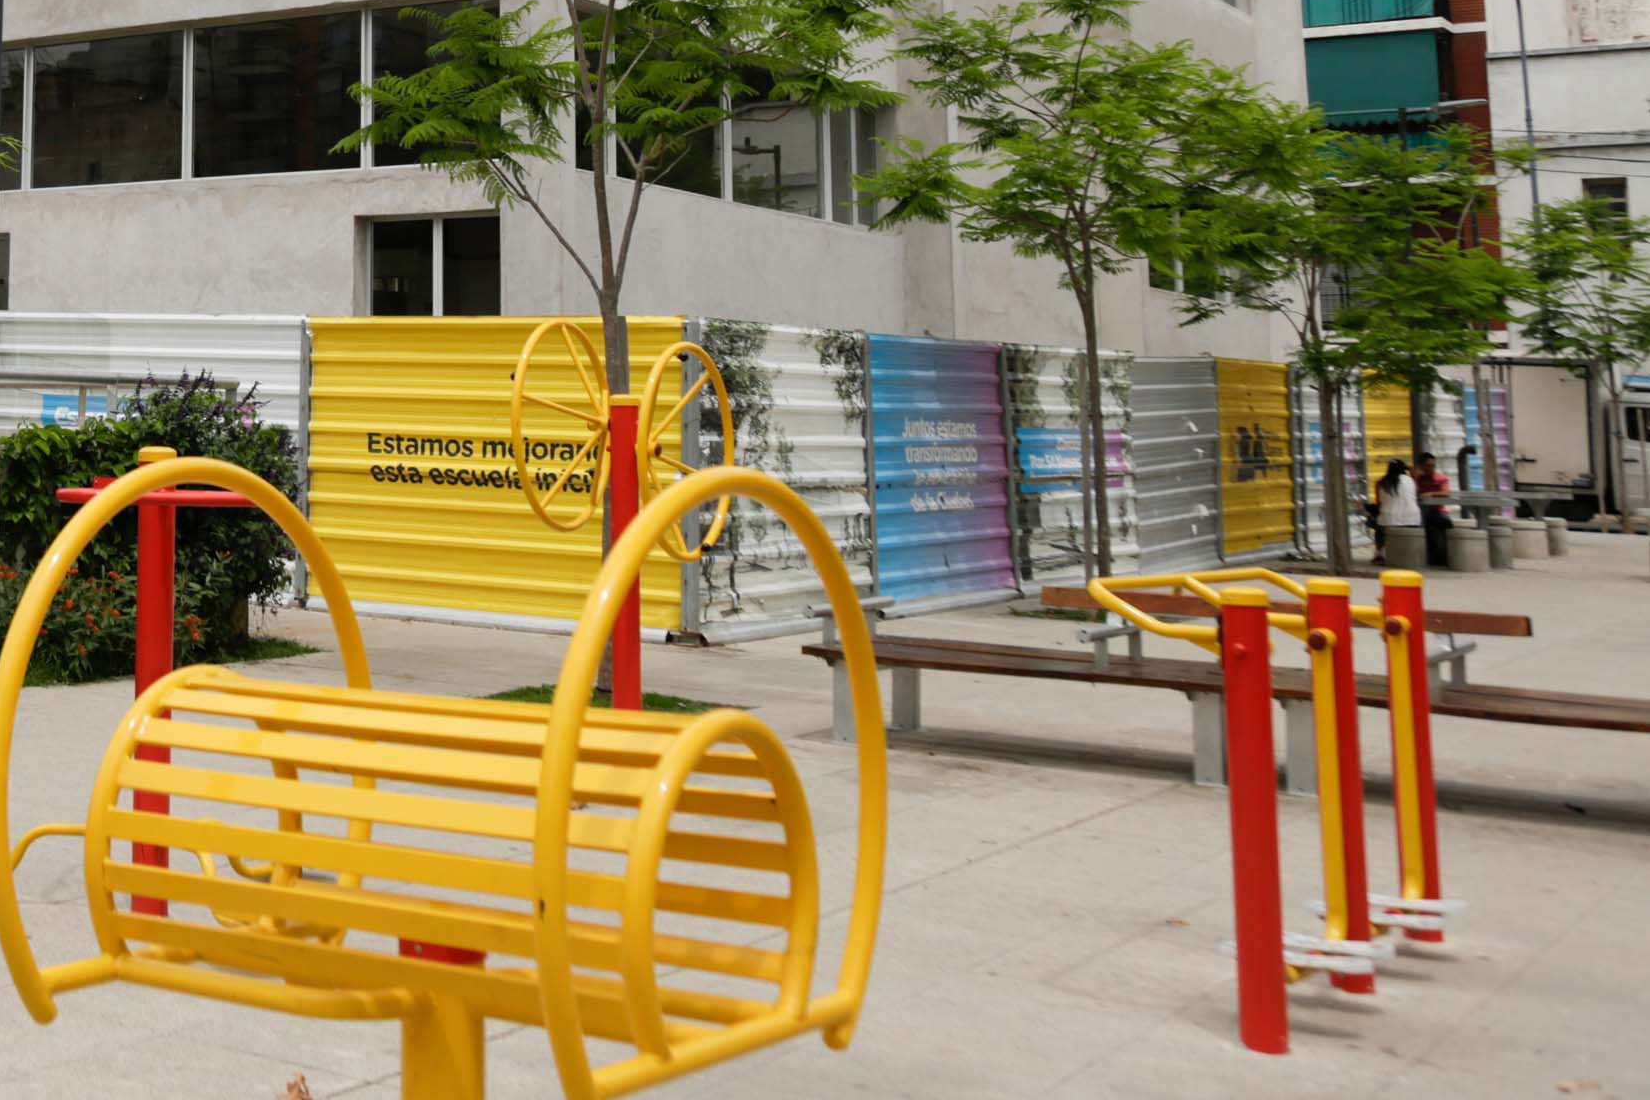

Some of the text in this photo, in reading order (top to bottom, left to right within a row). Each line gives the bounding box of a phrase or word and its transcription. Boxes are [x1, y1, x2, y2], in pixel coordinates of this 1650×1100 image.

[366, 432, 474, 459] Estamos
[370, 463, 596, 494] esta escuela inici
